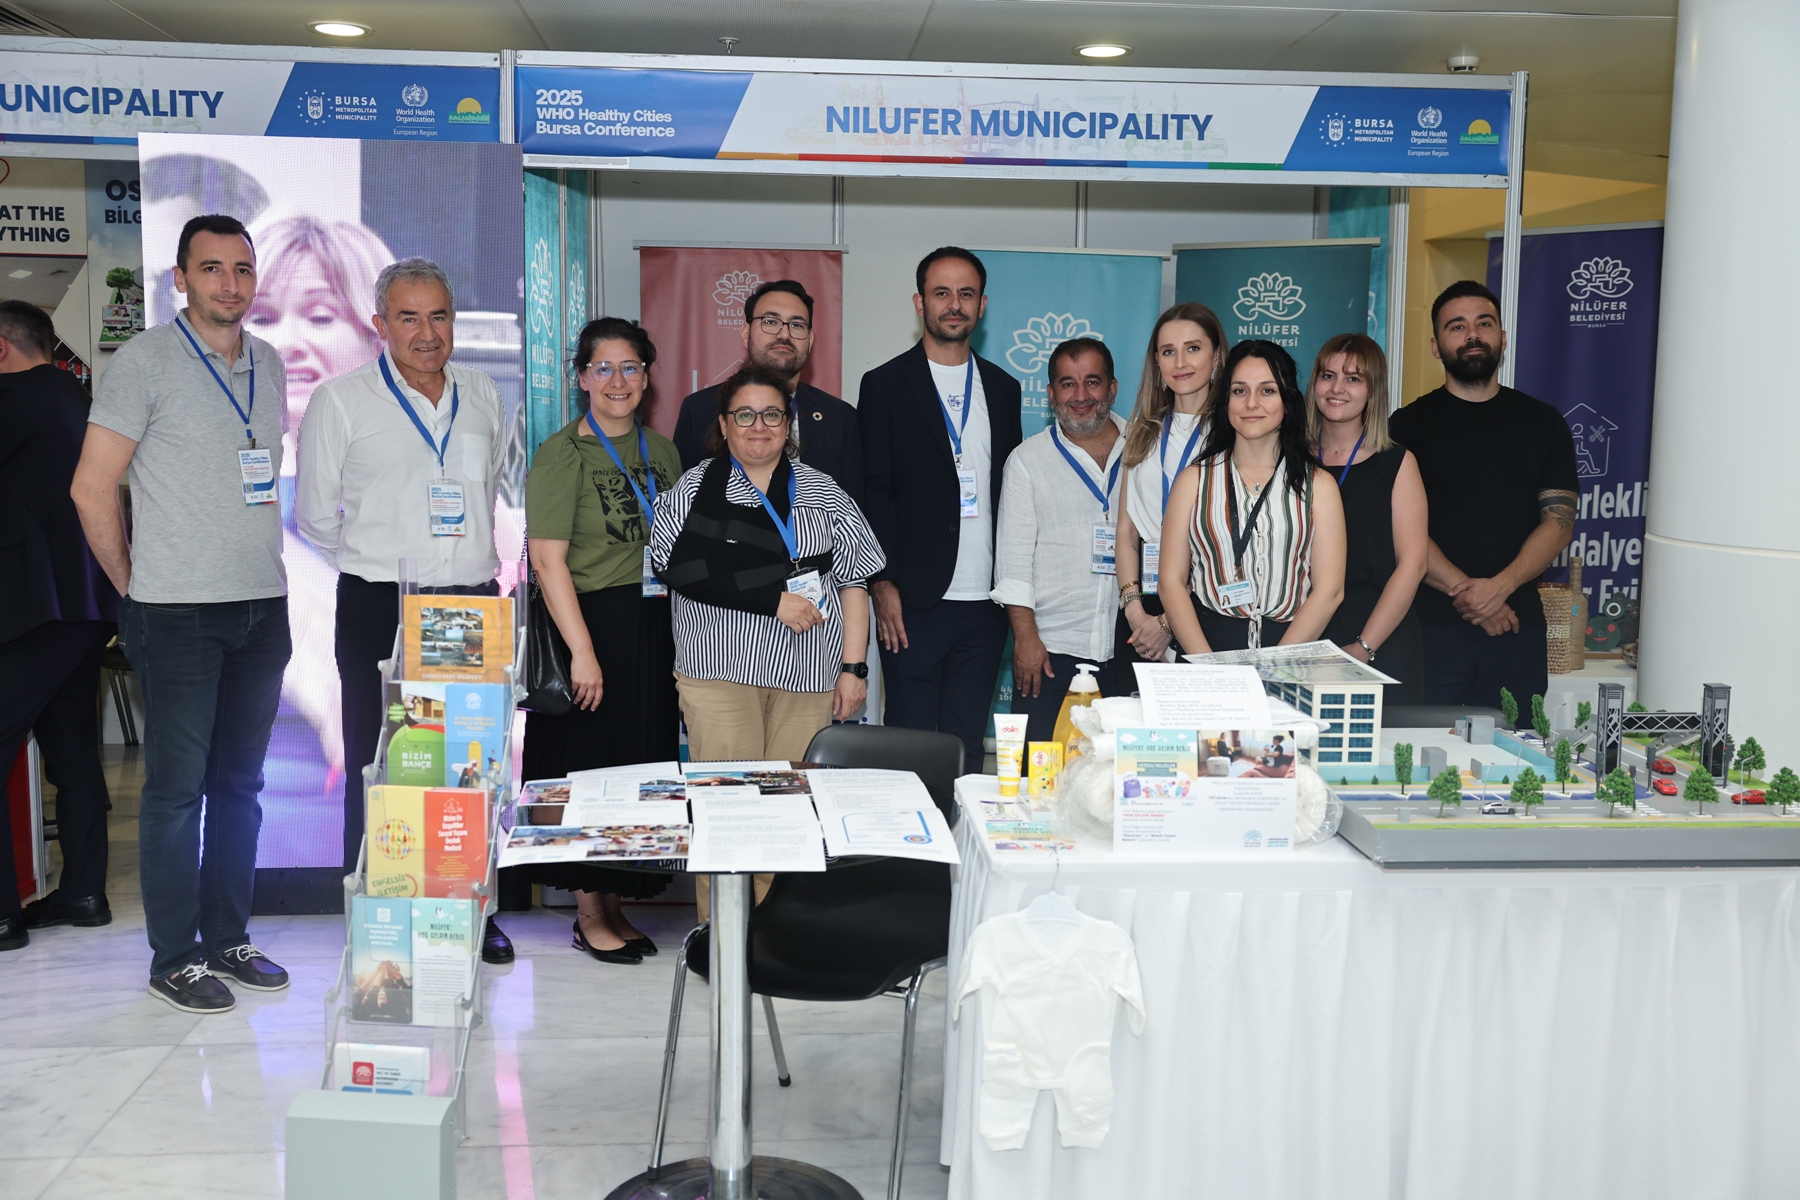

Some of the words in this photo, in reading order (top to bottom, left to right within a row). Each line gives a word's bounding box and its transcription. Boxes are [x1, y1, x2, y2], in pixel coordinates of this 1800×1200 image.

[0, 84, 224, 118] UNICIPALITY
[336, 96, 376, 106] BURSA
[536, 88, 583, 105] 2025
[396, 108, 415, 116] World
[416, 109, 435, 117] Health
[536, 107, 574, 120] WHO
[578, 108, 631, 124] Healthy
[633, 109, 672, 122] Cities
[396, 116, 435, 124] Organization
[826, 105, 962, 136] NILUFER
[970, 109, 1213, 141] MUNICIPALITY
[1355, 118, 1393, 128] BURSA
[419, 129, 438, 137] Region
[536, 120, 581, 135] Bursa
[584, 122, 675, 137] Conference
[1429, 130, 1448, 138] Health
[28, 206, 65, 222] THE
[1570, 300, 1627, 312] NİLÜFER
[1569, 312, 1626, 322] BELEDİYESİ
[1238, 322, 1300, 335] NİLÜFER
[1003, 725, 1018, 733] dalin
[402, 751, 432, 760] BİZİM
[402, 760, 432, 770] BAHÇE
[372, 874, 406, 888] ENGELSİZ
[377, 884, 409, 897] İLETİŞİM
